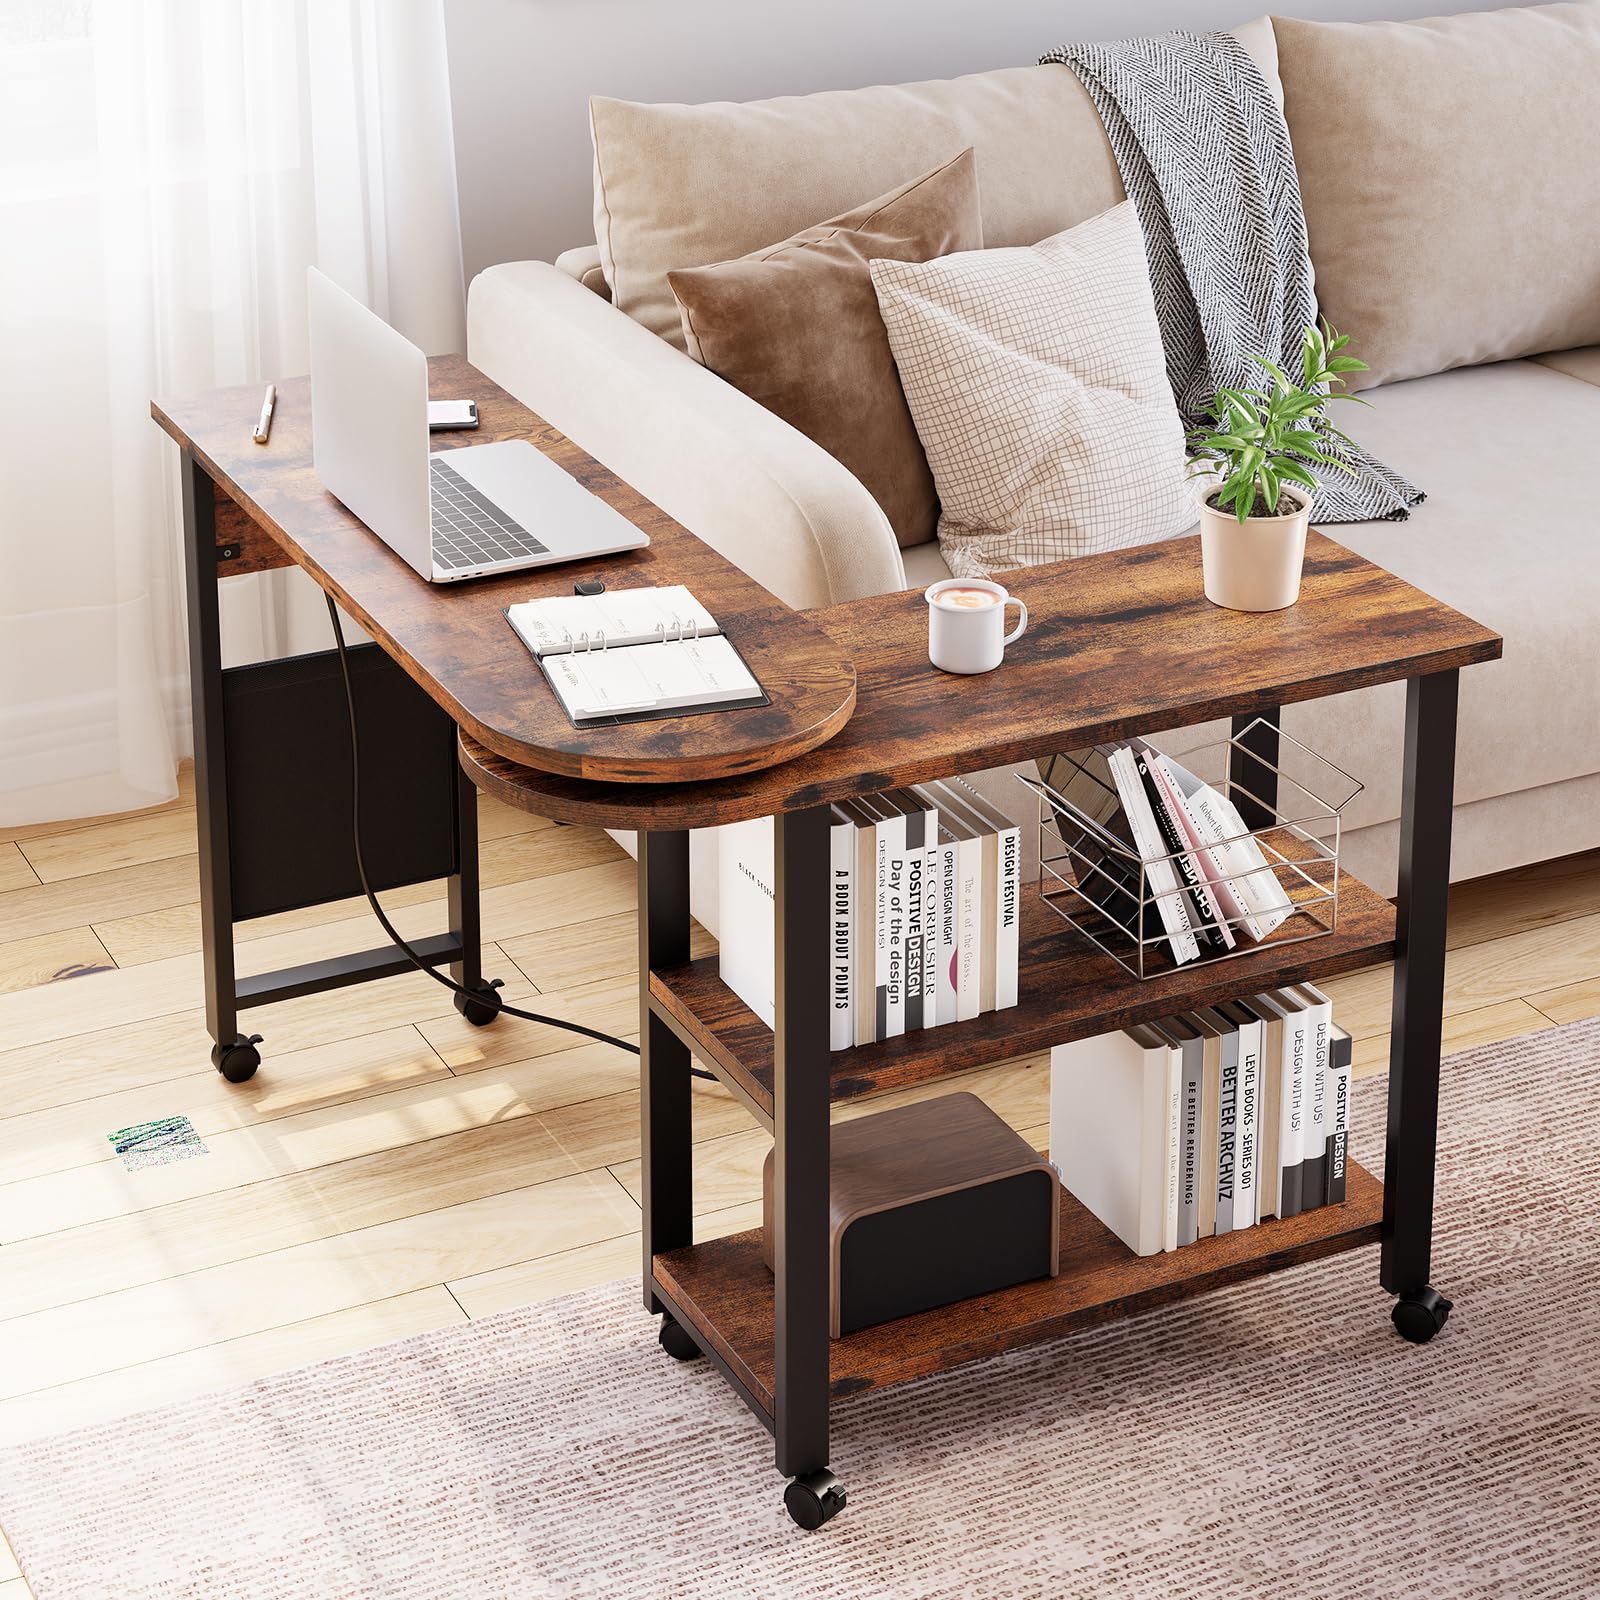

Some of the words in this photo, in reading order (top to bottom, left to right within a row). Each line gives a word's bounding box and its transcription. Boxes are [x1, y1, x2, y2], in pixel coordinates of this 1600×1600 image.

[1199, 801, 1218, 829] Robert
[927, 850, 937, 875] LE
[944, 851, 953, 877] OPEN
[1004, 836, 1015, 876] DESIGN
[890, 860, 903, 891] Day
[965, 878, 973, 894] The
[835, 884, 849, 916] BOOK
[878, 891, 886, 924] WITH
[890, 897, 903, 916] of
[908, 859, 922, 933] POSITIVE
[943, 879, 953, 916] DESIGN
[1003, 880, 1014, 928] FESTIVAL
[835, 921, 849, 959] ABOUT
[890, 918, 903, 945] the
[924, 880, 937, 996] CORBUSIER
[943, 916, 952, 946] NIGHT
[964, 918, 973, 929] of
[964, 934, 973, 948] the
[888, 950, 903, 1005] design
[907, 937, 921, 998] DESIGN
[835, 966, 849, 1009] POINTS
[1293, 1030, 1305, 1075] DESIGN
[1315, 1022, 1327, 1067] DESIGN
[1245, 1053, 1255, 1086] LEVEL
[1314, 1070, 1324, 1101] WITH
[1188, 1082, 1196, 1093] BE
[1221, 1065, 1237, 1128] BETTER
[1292, 1077, 1302, 1109] WITH
[1335, 1075, 1347, 1131] POSITIVE
[1187, 1098, 1196, 1135] BETTER
[1243, 1088, 1255, 1126] BOOKS
[1291, 1112, 1301, 1132] US!
[1313, 1105, 1323, 1125] US!
[1218, 1131, 1235, 1202] ARCHVIZ
[1242, 1134, 1253, 1169] SERIES
[1333, 1133, 1345, 1179] DESIGN
[1185, 1139, 1194, 1205] RENDERINGS
[1241, 1171, 1252, 1190] 001
